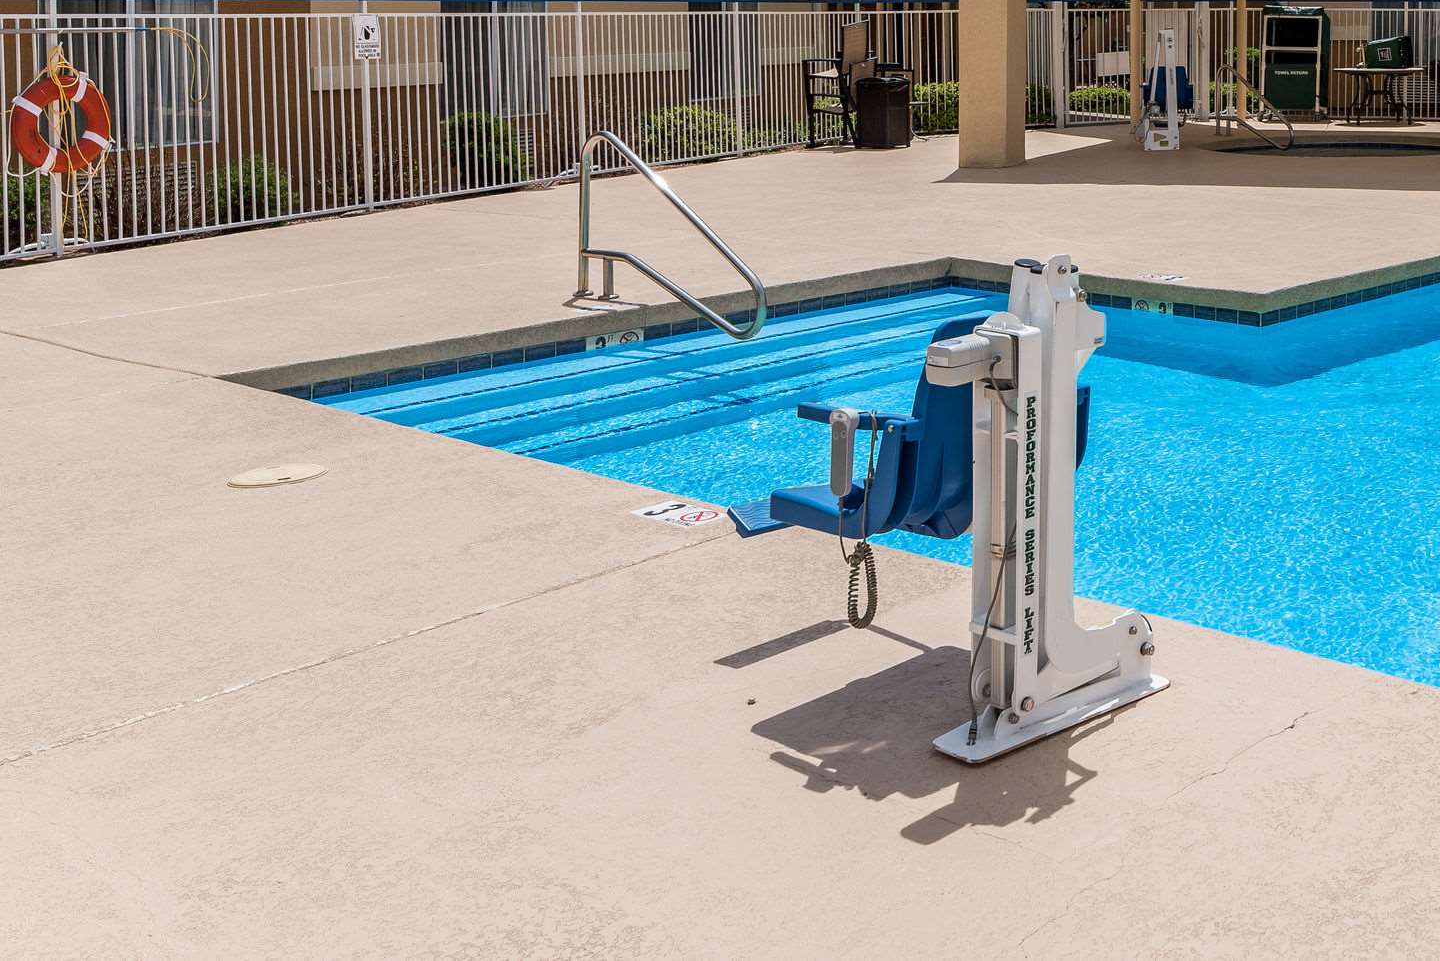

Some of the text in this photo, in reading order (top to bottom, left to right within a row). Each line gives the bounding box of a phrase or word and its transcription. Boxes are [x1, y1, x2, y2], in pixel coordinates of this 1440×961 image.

[643, 503, 687, 516] 3
[1024, 396, 1036, 654] PROFORMANCE SERIES LIFT
